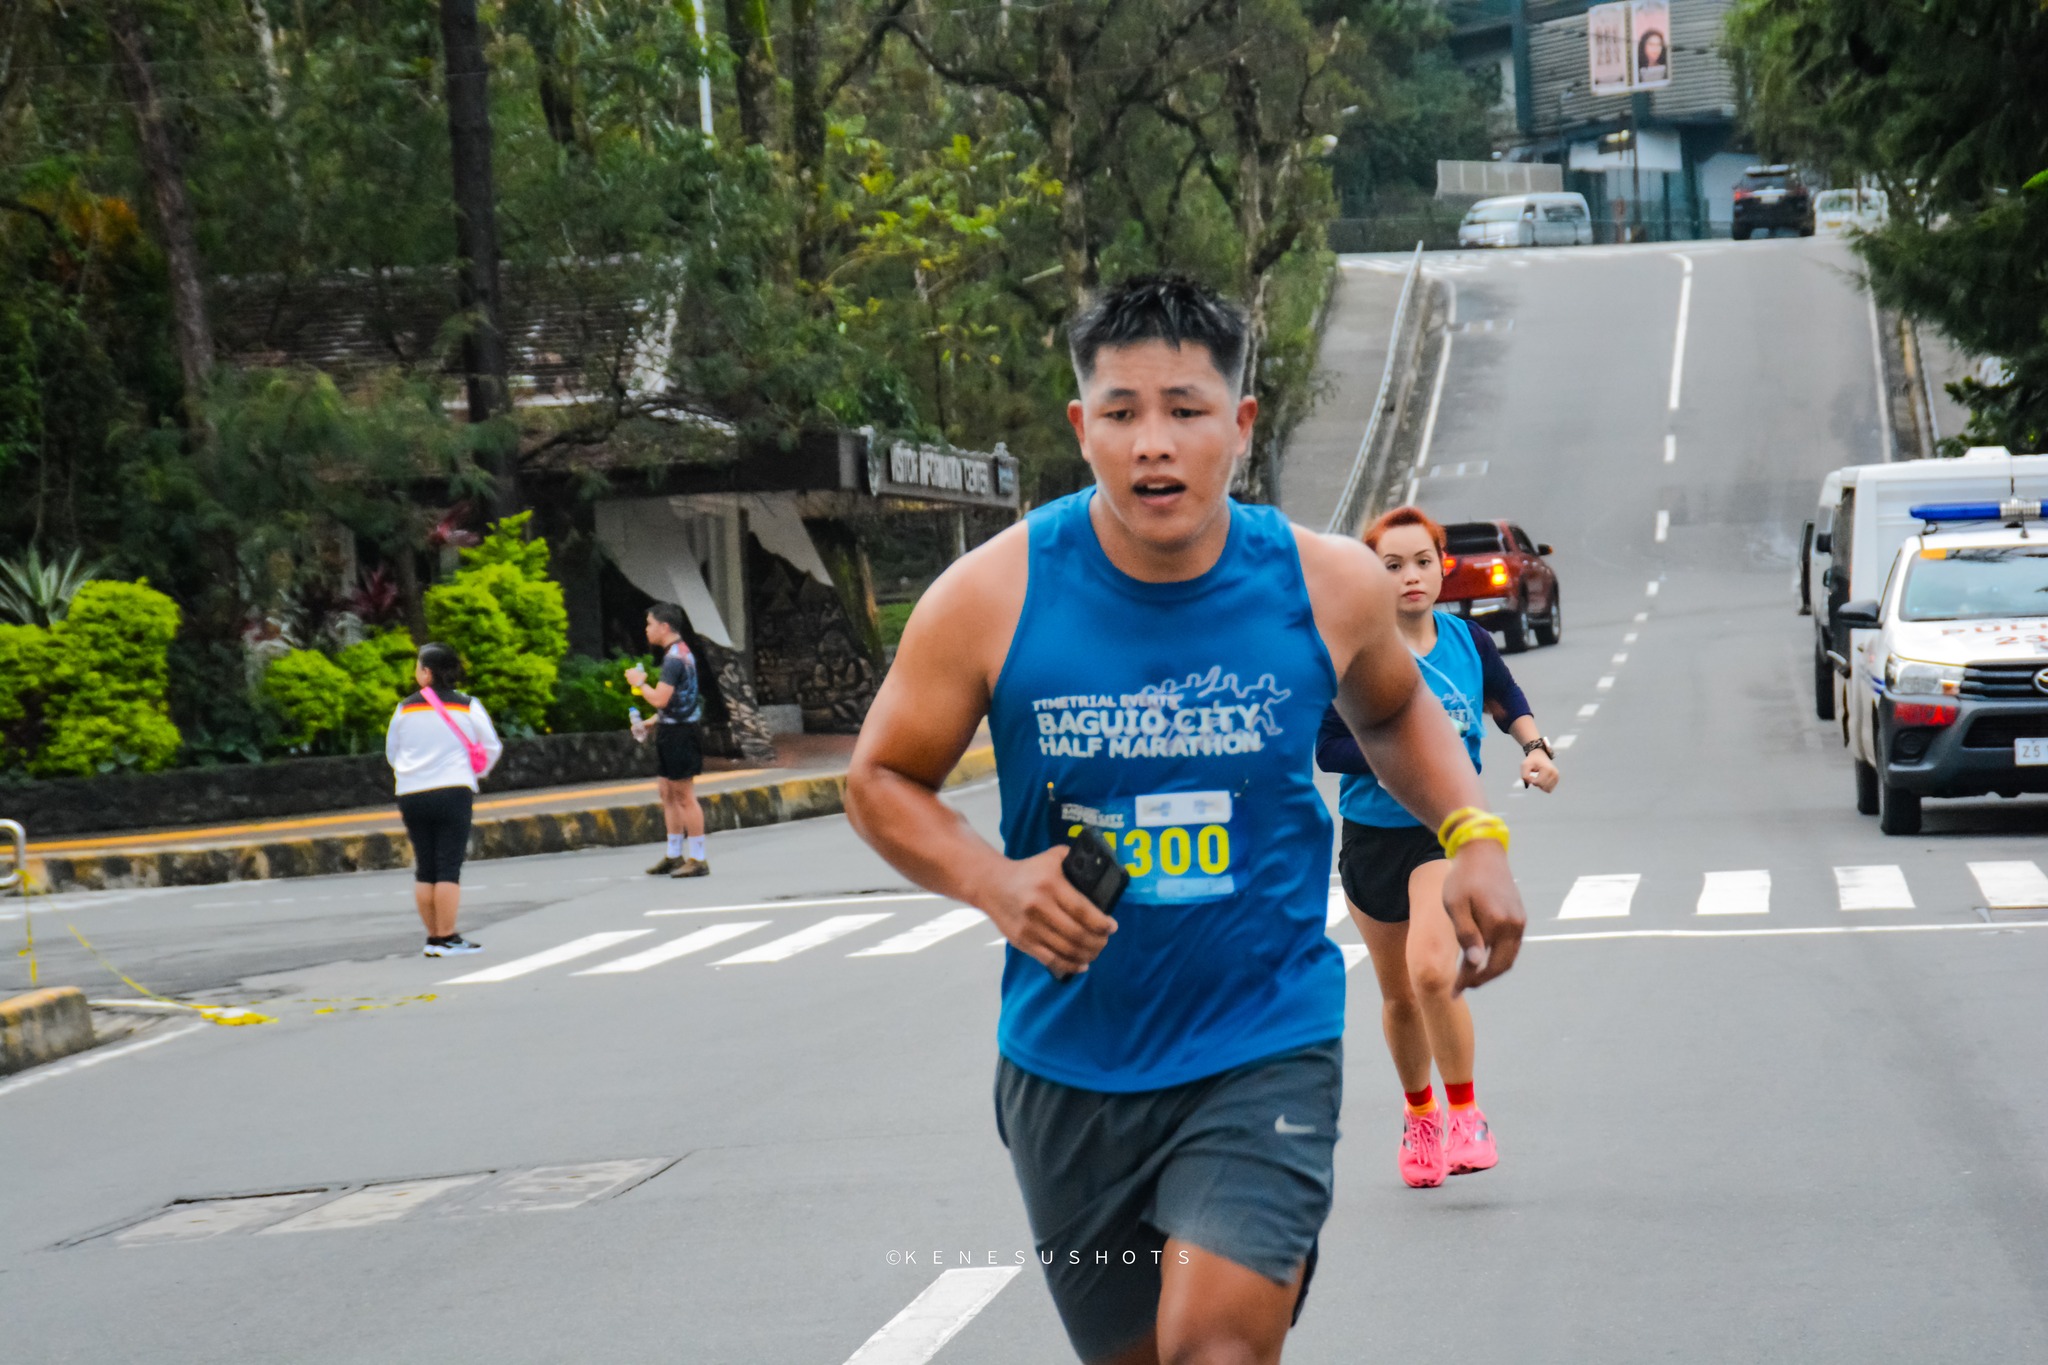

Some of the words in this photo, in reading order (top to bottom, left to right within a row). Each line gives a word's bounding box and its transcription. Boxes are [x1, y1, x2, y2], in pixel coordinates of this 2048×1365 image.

[1032, 693, 1117, 711] TIMETRIAL
[1120, 692, 1184, 711] EVENTS
[1036, 709, 1168, 737] BAGUIO
[1173, 702, 1262, 733] CITY
[1038, 735, 1104, 758] HALF
[1108, 731, 1262, 759] MARATHON
